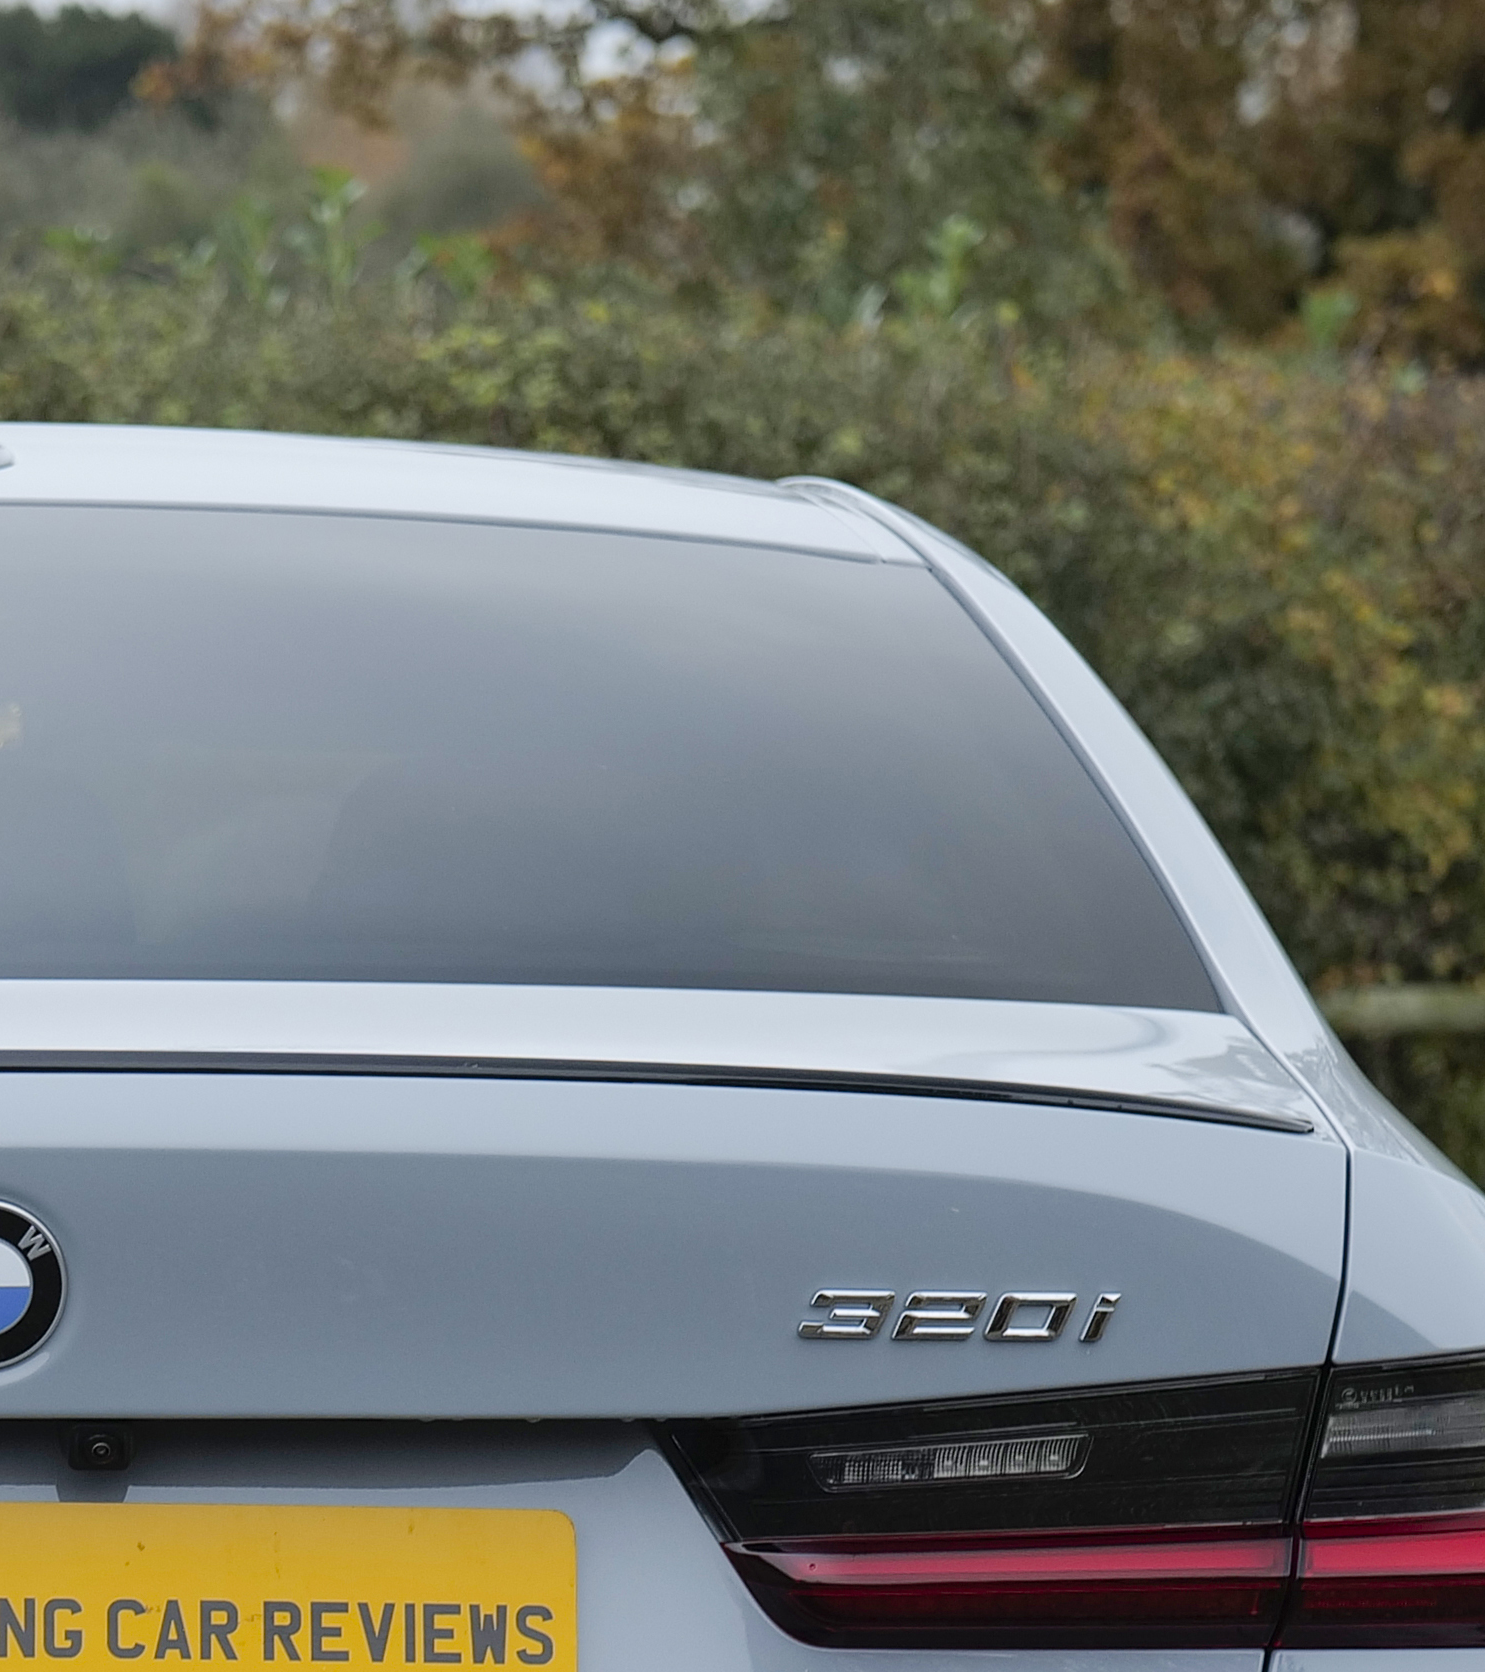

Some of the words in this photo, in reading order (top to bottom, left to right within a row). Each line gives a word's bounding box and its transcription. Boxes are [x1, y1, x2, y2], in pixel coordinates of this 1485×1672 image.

[797, 1288, 1122, 1343] 320i
[106, 1599, 239, 1661] CAR
[263, 1600, 554, 1665] REVIEWS
